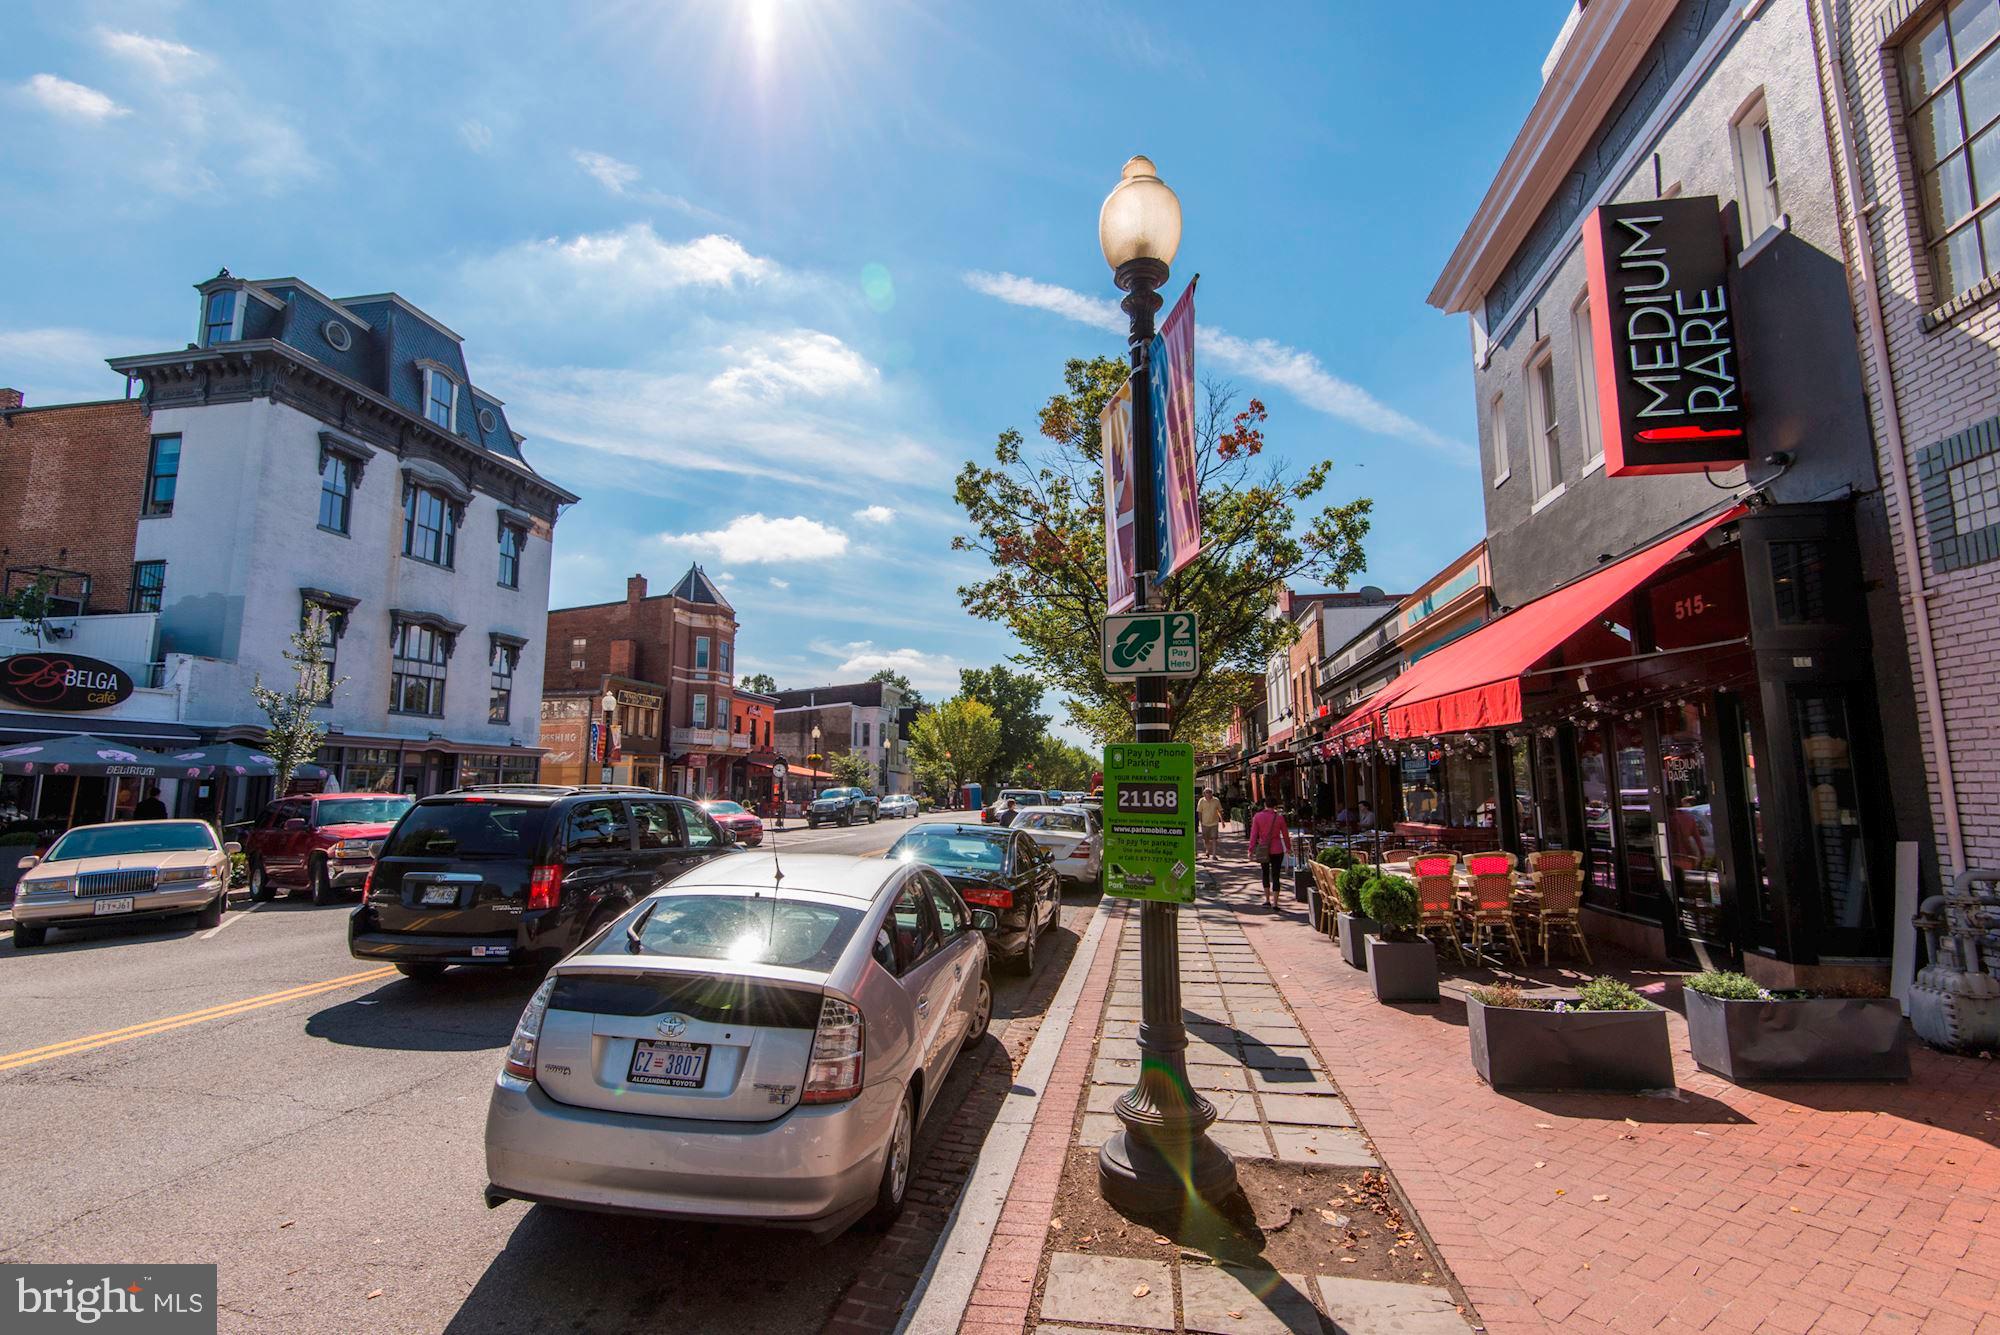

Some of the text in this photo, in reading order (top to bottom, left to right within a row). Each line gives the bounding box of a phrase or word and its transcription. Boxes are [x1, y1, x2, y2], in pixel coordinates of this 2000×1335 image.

[1616, 216, 1684, 417] MEDIUM
[1675, 285, 1738, 414] RARE
[1675, 595, 1704, 620] 515
[1172, 615, 1190, 639] 2
[1172, 648, 1188, 658] Pay
[65, 669, 118, 691] BELGA
[87, 691, 116, 704] café
[1127, 748, 1186, 758] Pay by Phone
[1127, 758, 1160, 768] Parking
[1666, 759, 1701, 770] MEDIUM
[105, 765, 156, 776] DELIRIUM
[1668, 770, 1690, 782] RARE
[1119, 790, 1177, 808] 21168
[1113, 826, 1183, 835] www.parkmobile.com
[1128, 839, 1138, 847] pay
[1140, 838, 1149, 846] for
[634, 1051, 702, 1077] CZ 3807
[632, 1076, 697, 1088] ALEXANDRIA TOYOTA
